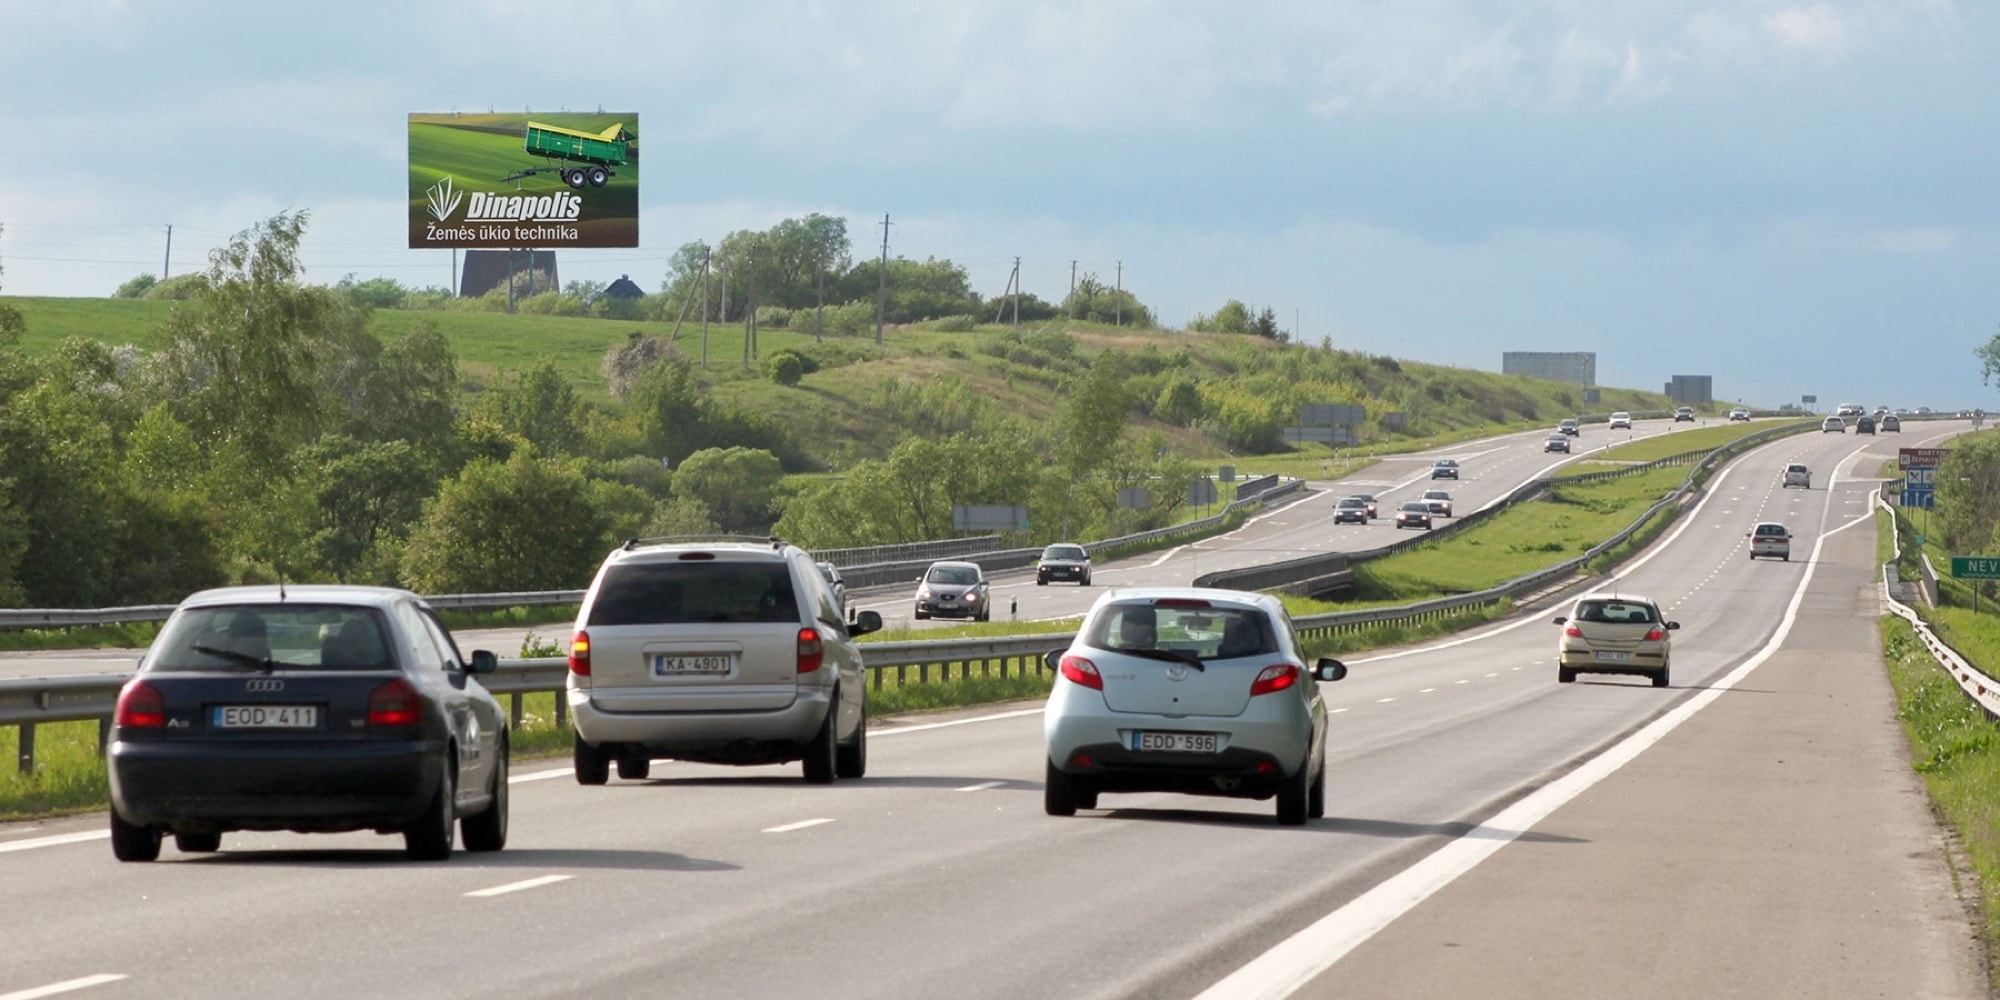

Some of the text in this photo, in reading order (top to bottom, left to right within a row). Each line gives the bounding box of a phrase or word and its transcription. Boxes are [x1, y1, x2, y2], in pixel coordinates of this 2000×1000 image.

[467, 191, 582, 221] Dinapolis
[427, 222, 578, 240] Žemės ūkio technika
[1968, 560, 1998, 572] NEV
[225, 708, 311, 724] EOD 411
[1143, 735, 1213, 750] EDD 596
